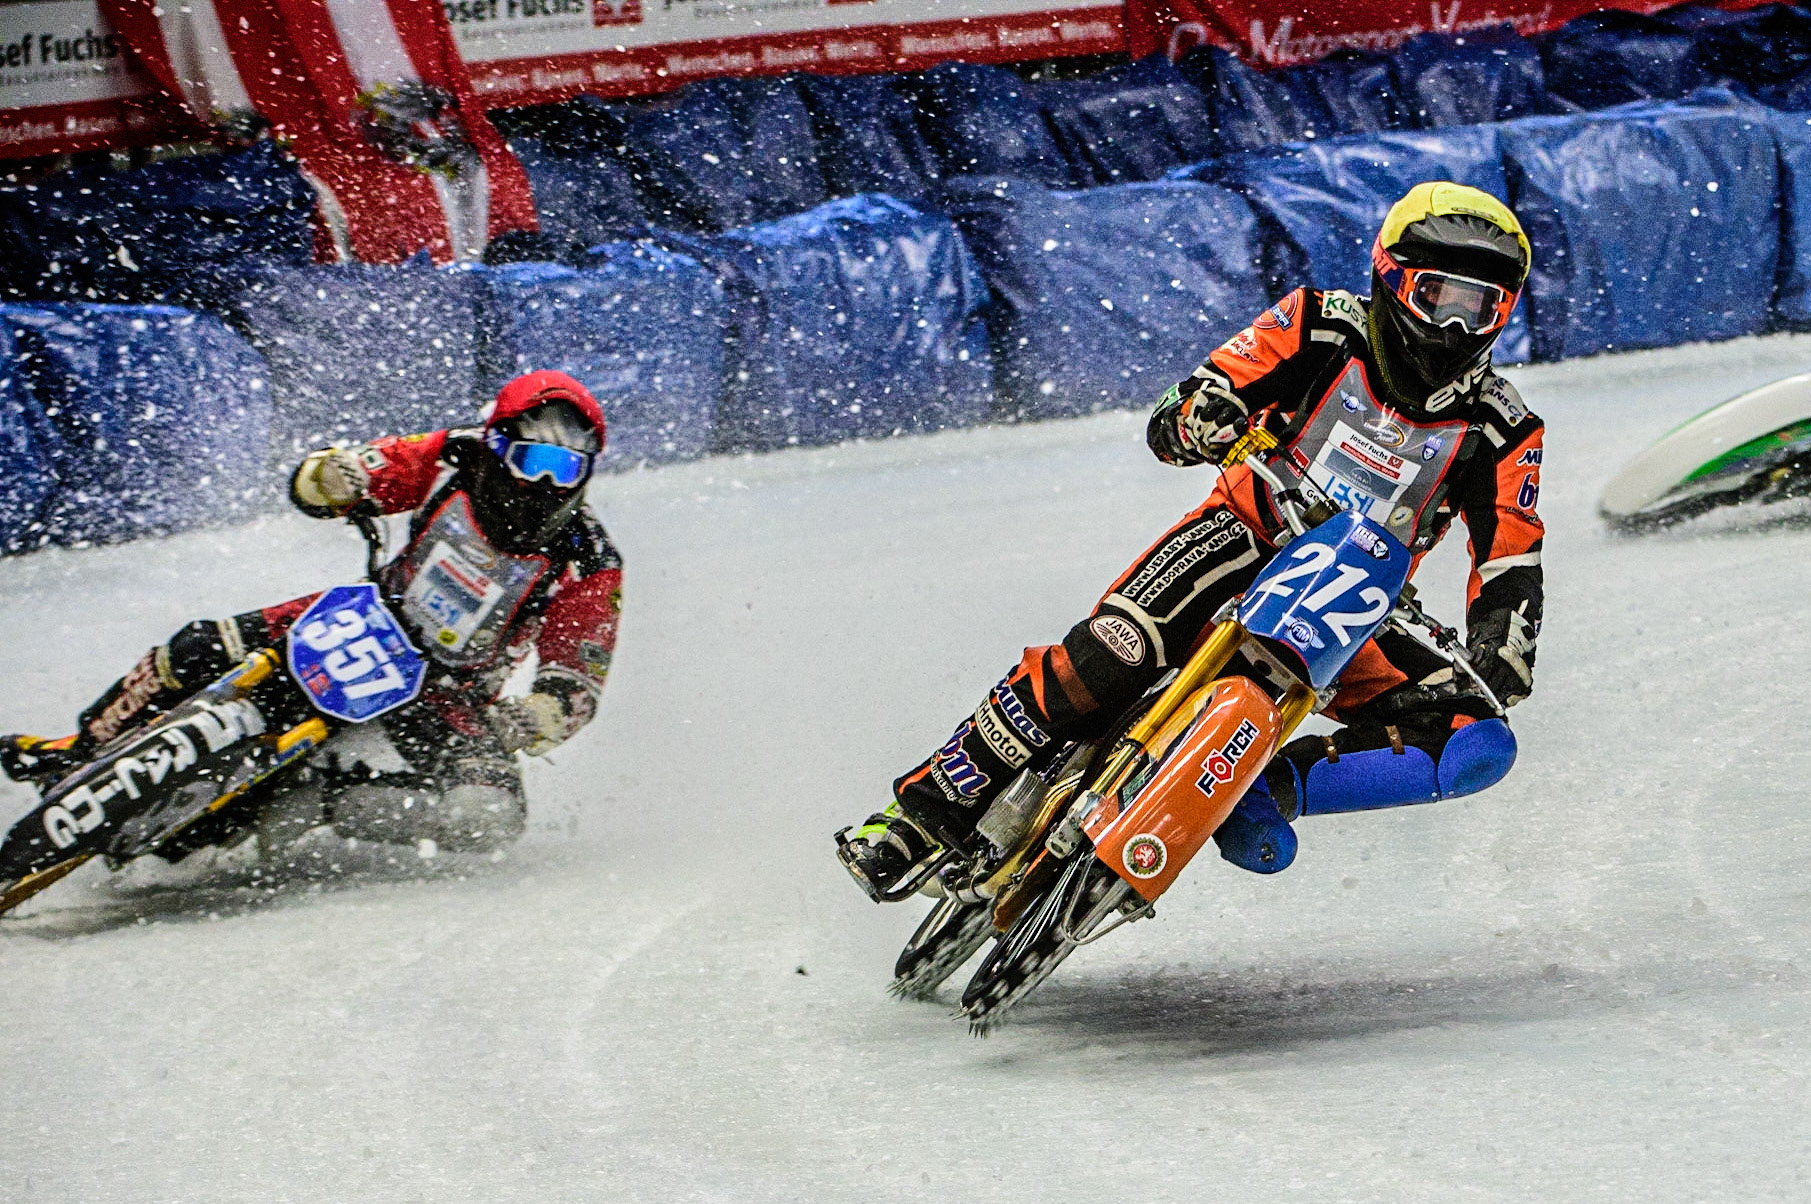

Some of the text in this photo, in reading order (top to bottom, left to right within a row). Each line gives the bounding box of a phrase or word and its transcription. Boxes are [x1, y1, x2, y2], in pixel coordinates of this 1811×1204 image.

[40, 28, 119, 63] Fuchs
[1350, 434, 1370, 448] Josef
[1368, 445, 1388, 461] Fuchs
[1252, 541, 1390, 648] 212
[1105, 619, 1140, 652] JAWA
[1291, 625, 1310, 643] FIM
[301, 609, 407, 700] 357
